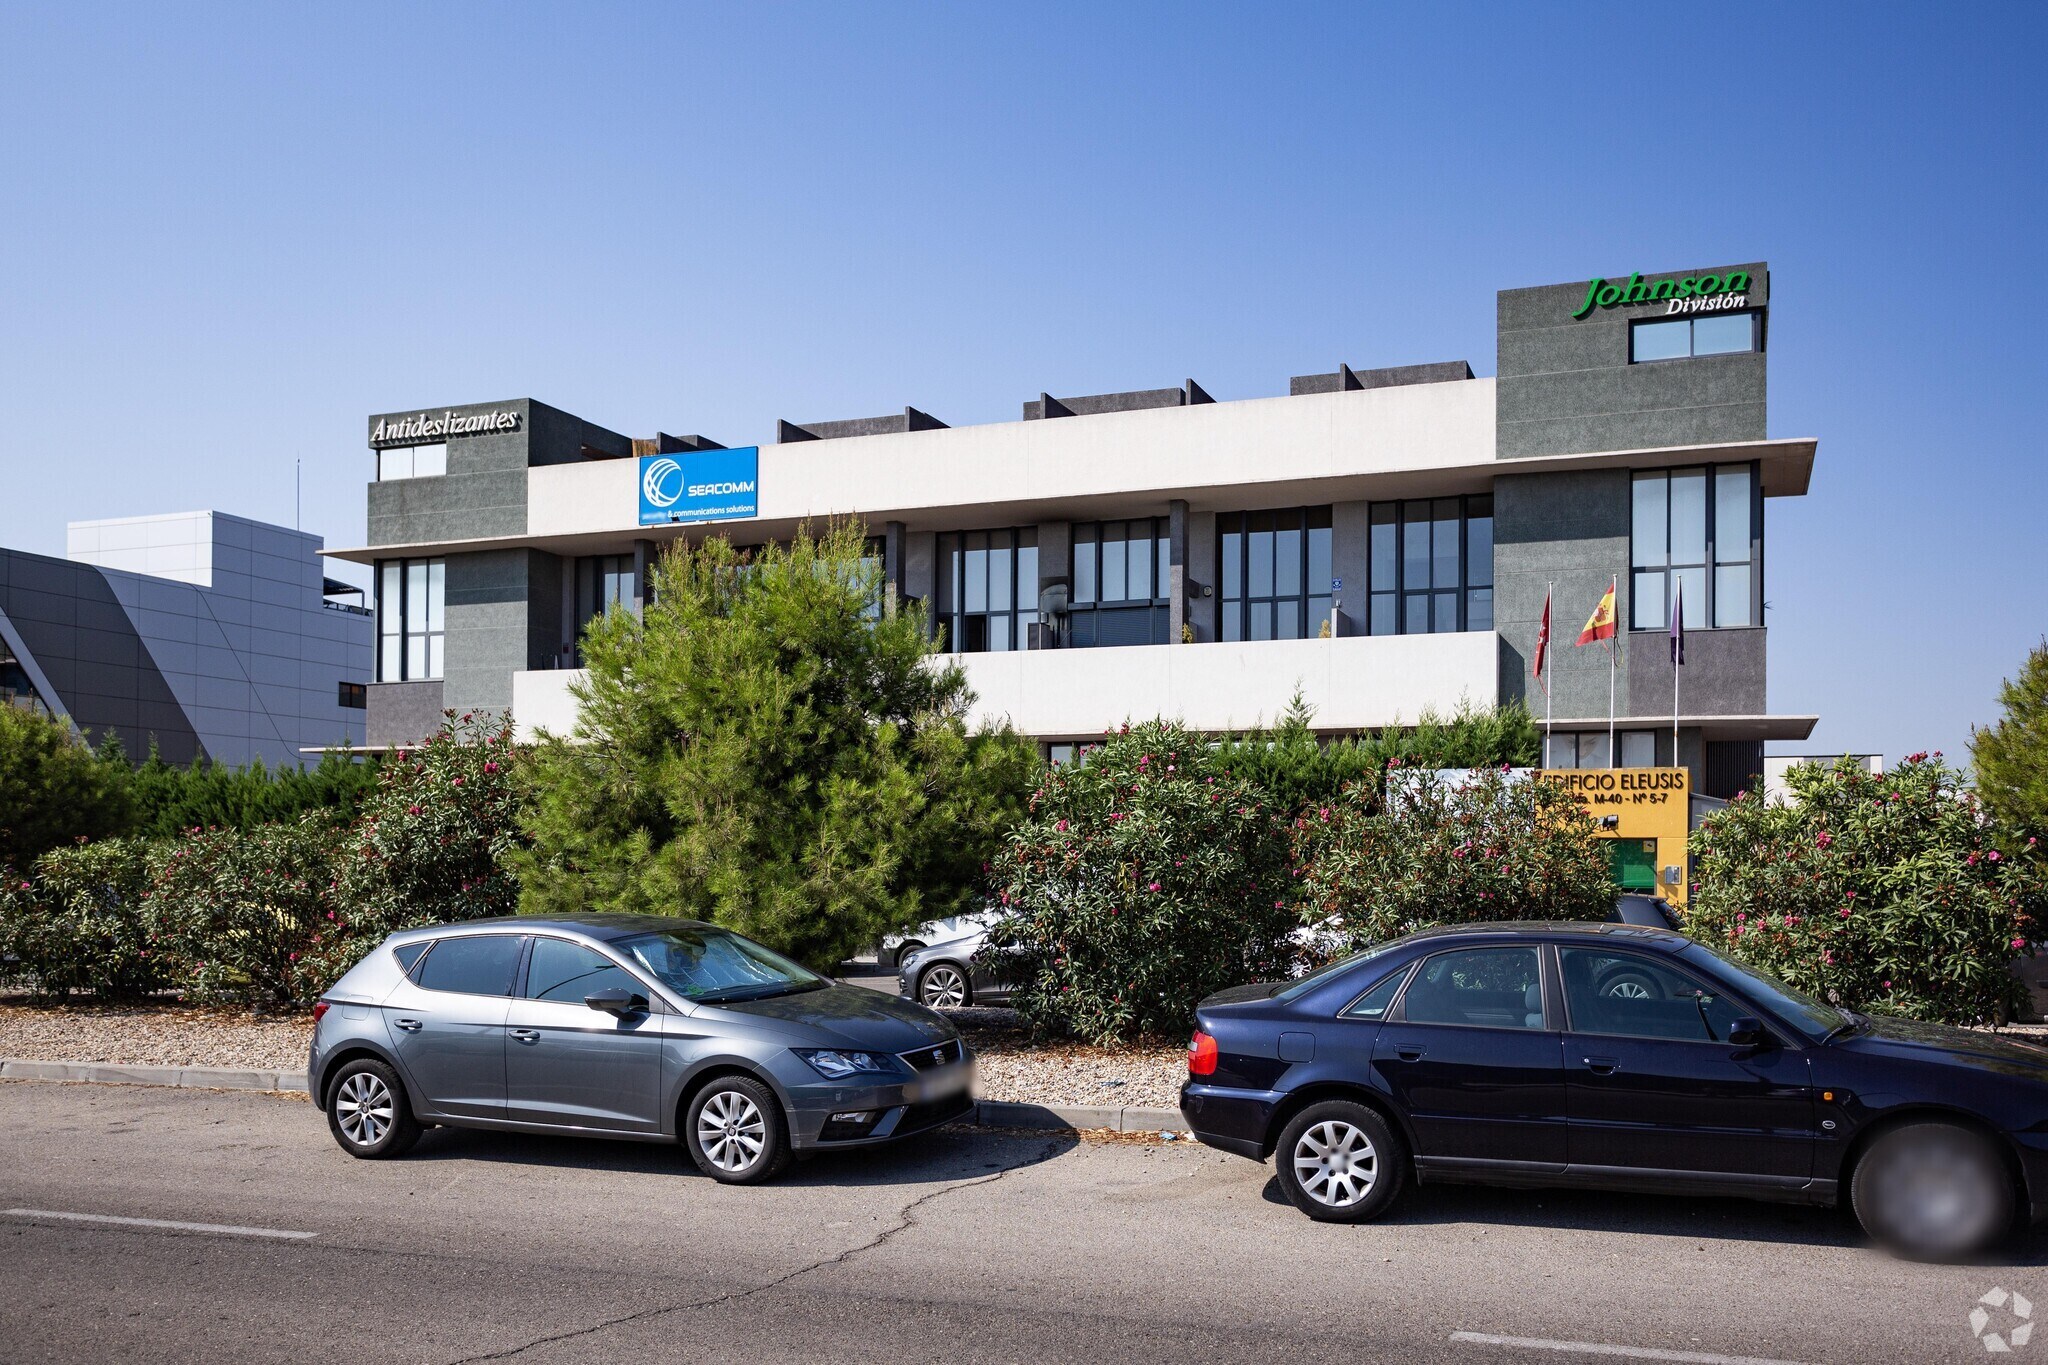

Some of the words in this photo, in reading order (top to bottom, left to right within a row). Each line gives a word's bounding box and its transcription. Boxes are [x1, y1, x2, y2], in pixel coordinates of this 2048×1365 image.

[1572, 271, 1748, 317] Johnson
[1665, 292, 1745, 315] División
[370, 410, 518, 442] Antideslizantes
[688, 481, 754, 497] SEACOMM
[667, 510, 673, 518] &
[673, 507, 725, 517] communications
[726, 505, 755, 513] solutions
[1621, 773, 1684, 790] ELEUSIS
[1594, 793, 1623, 804] M-40
[1633, 793, 1648, 804] Nº
[1649, 793, 1668, 804] 5-7
